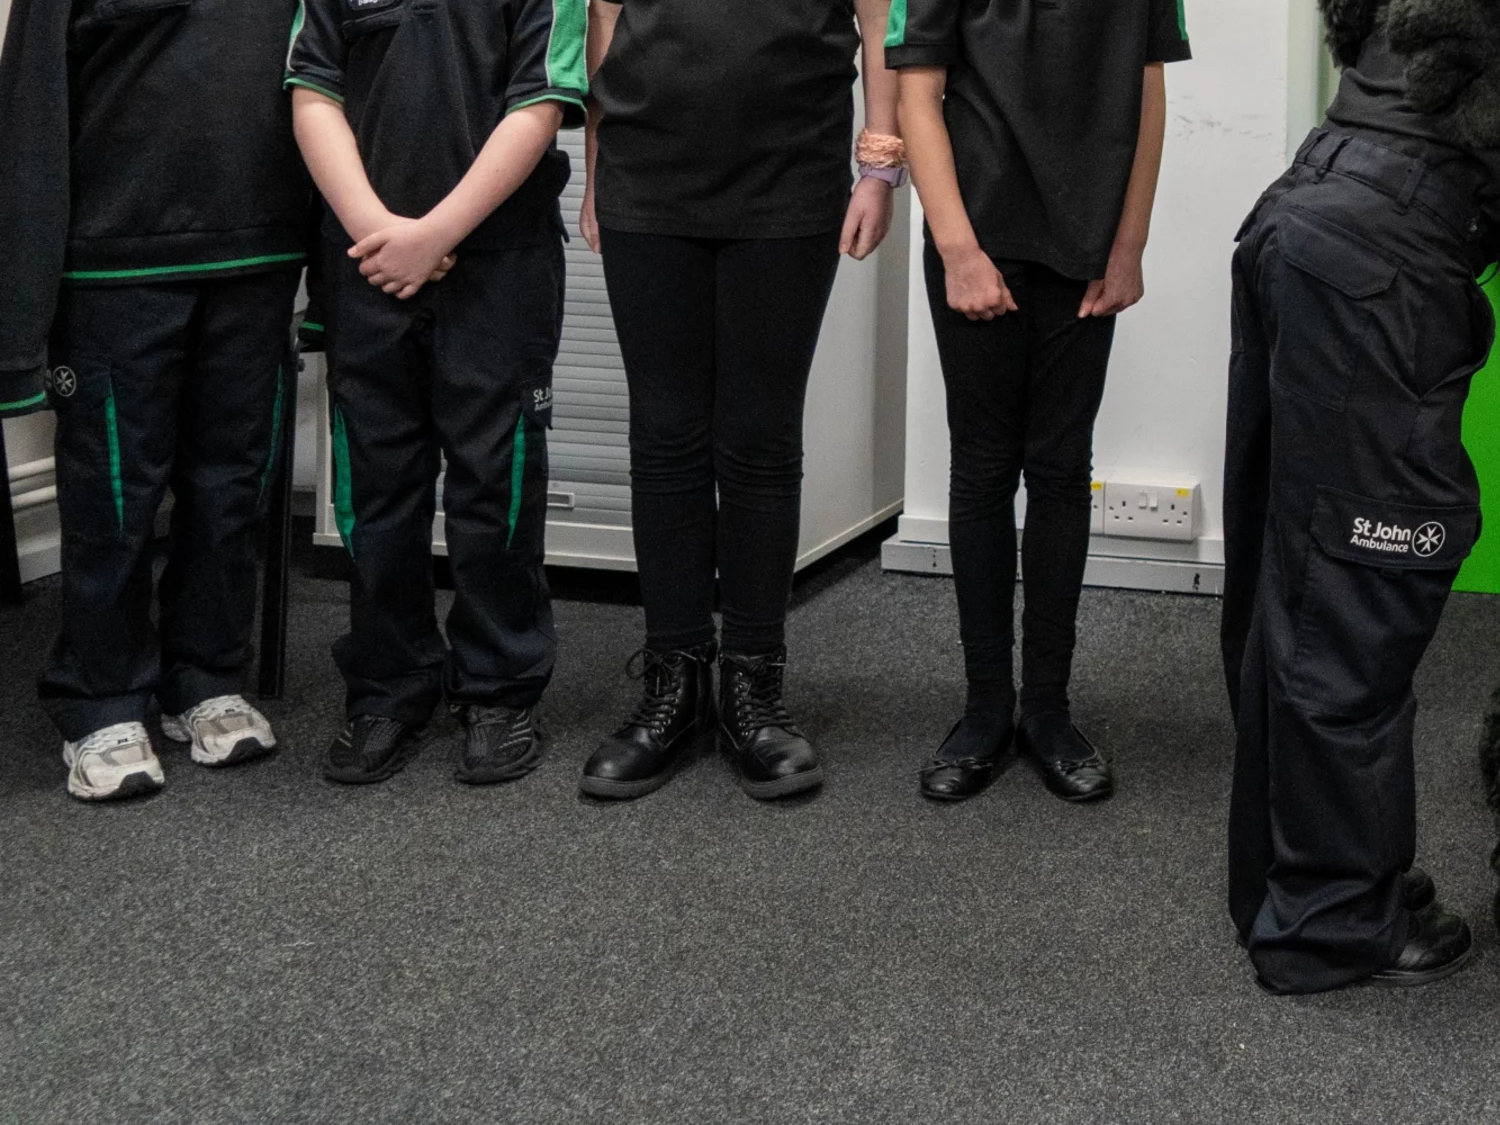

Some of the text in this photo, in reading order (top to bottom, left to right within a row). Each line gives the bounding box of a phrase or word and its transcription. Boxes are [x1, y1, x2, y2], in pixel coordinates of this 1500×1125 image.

[533, 389, 544, 403] St
[1352, 517, 1411, 542] St John
[1350, 535, 1409, 554] Ambulance
